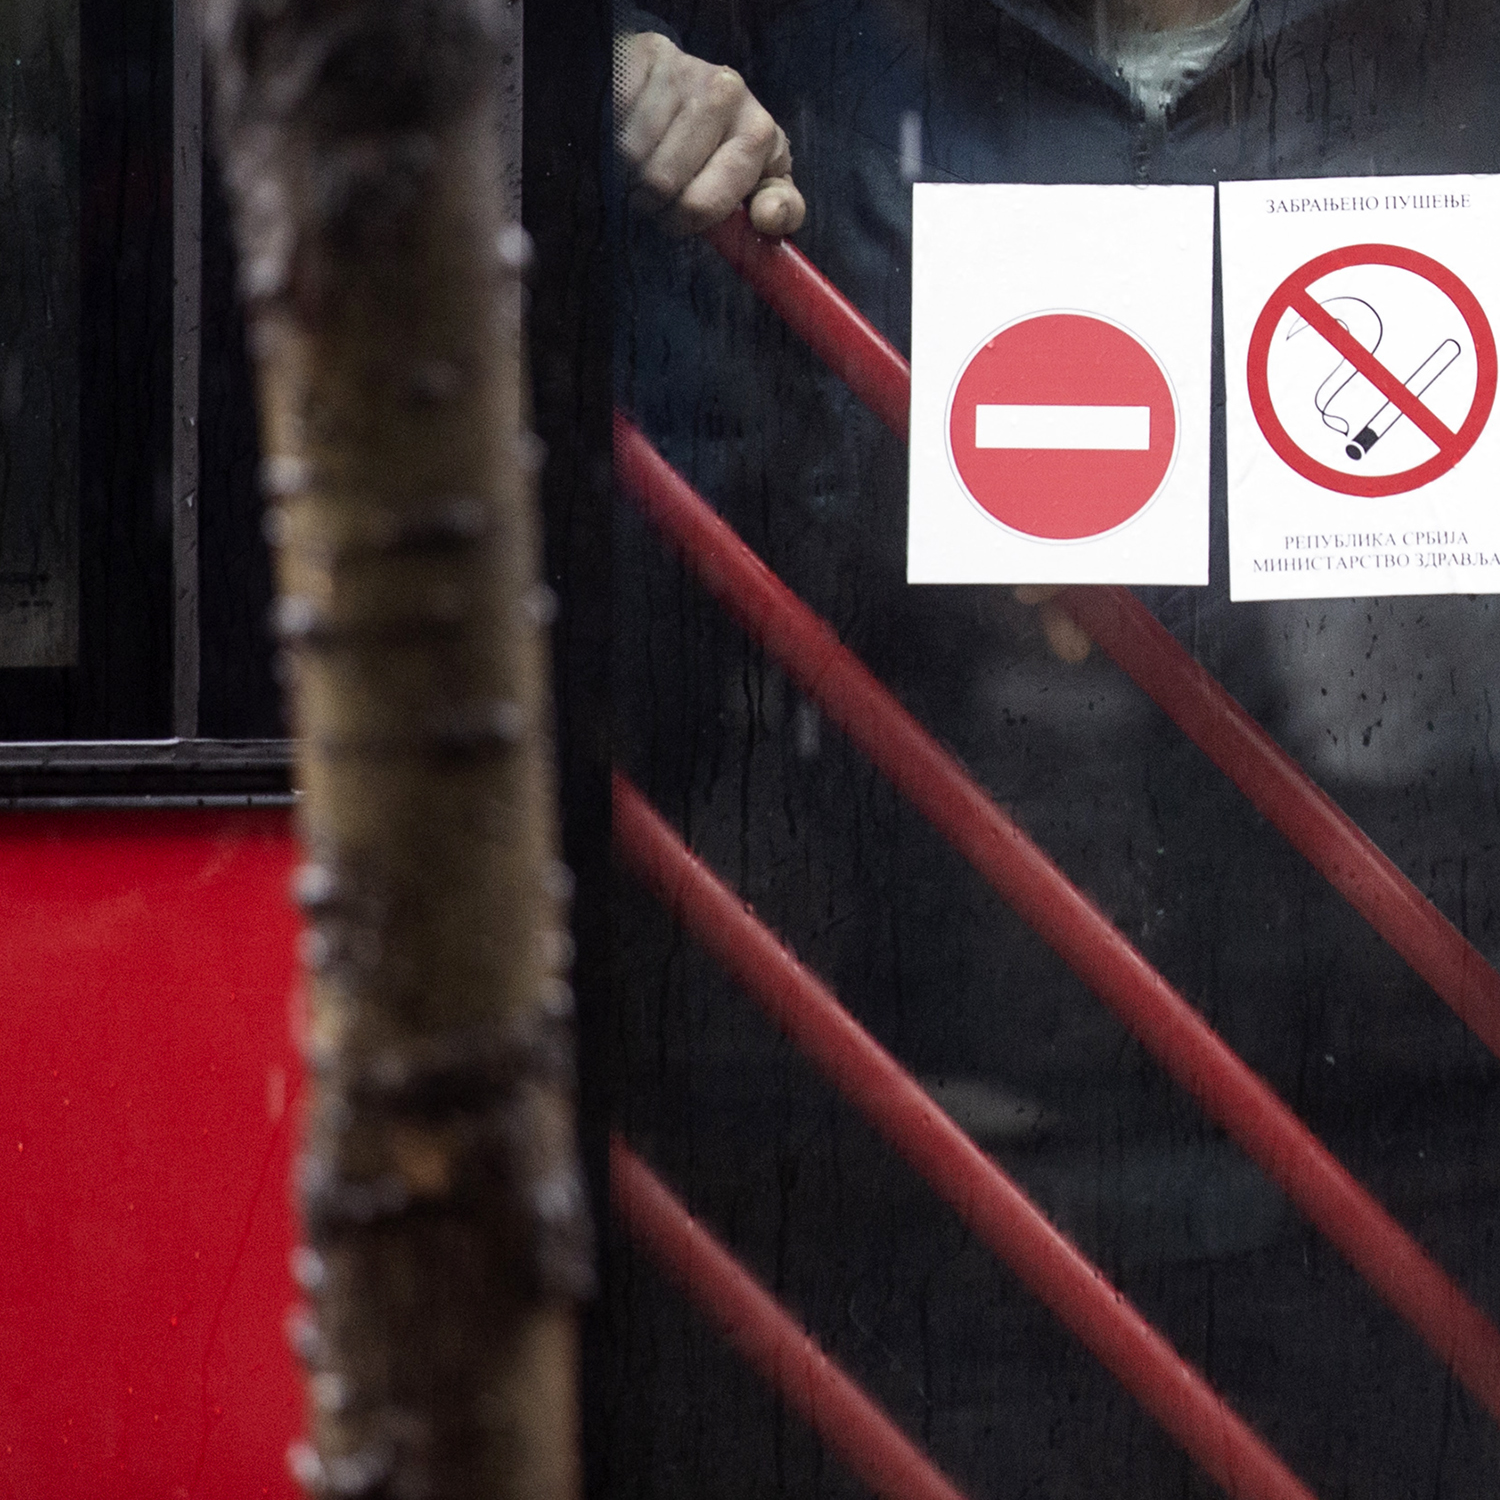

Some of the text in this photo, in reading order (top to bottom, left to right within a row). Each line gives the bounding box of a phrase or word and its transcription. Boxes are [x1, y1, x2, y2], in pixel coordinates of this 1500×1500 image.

[1266, 194, 1471, 214] ЗАБРАЊЕНО ПУШЕЊЕ
[1284, 530, 1468, 550] РЕПУБЛИКА СРБИЈА
[1254, 552, 1500, 572] МИНИСТАРСТВО ЗДРАВЉА
